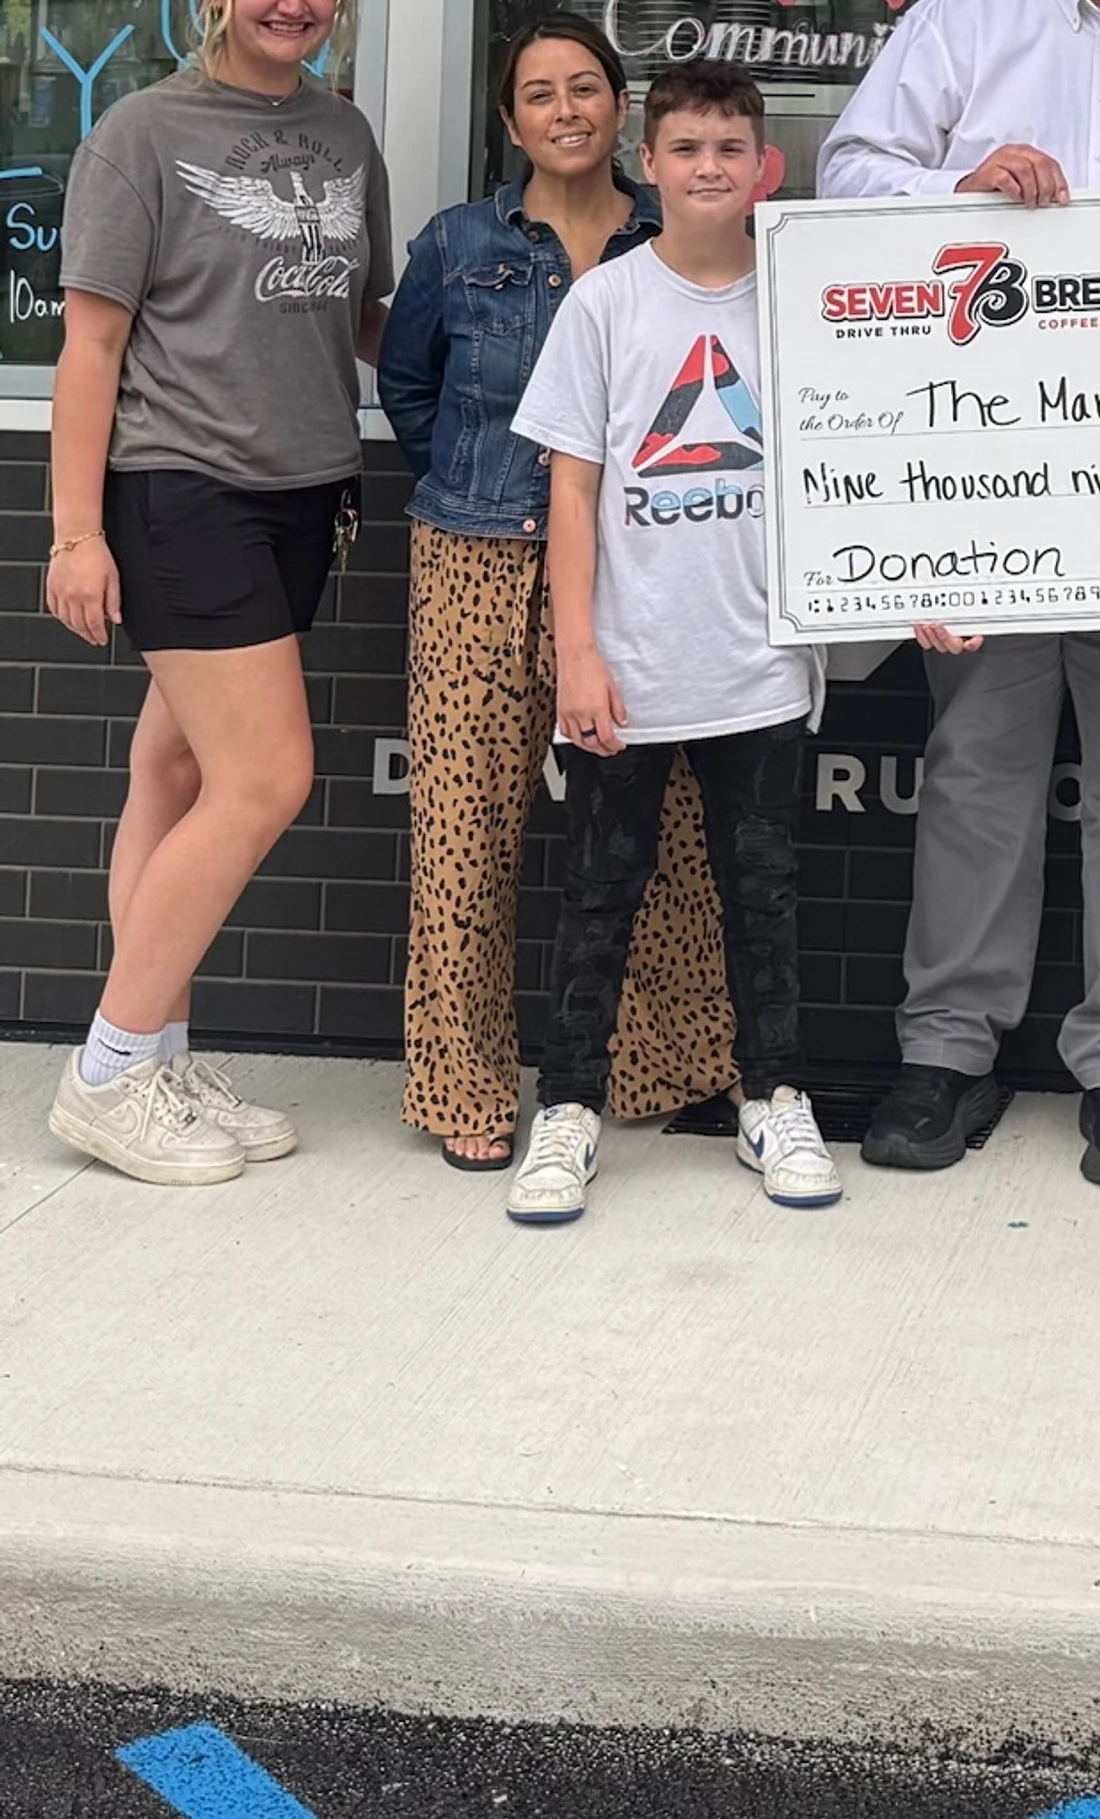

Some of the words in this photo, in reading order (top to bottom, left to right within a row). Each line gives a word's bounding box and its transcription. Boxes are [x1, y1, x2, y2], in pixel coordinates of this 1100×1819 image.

[225, 131, 270, 170] ROCK
[299, 132, 343, 172] ROLL
[822, 281, 945, 322] SEVEN
[835, 327, 883, 339] DRIVE
[890, 325, 931, 337] THRU
[1038, 316, 1099, 330] COFFEE
[798, 387, 831, 409] Pay
[833, 389, 849, 402] to
[906, 379, 1021, 427] The
[799, 414, 825, 431] the
[827, 411, 873, 430] Order
[802, 462, 883, 505] Nine
[900, 460, 1050, 502] thousand
[833, 540, 1066, 584] Donation
[803, 570, 835, 587] For
